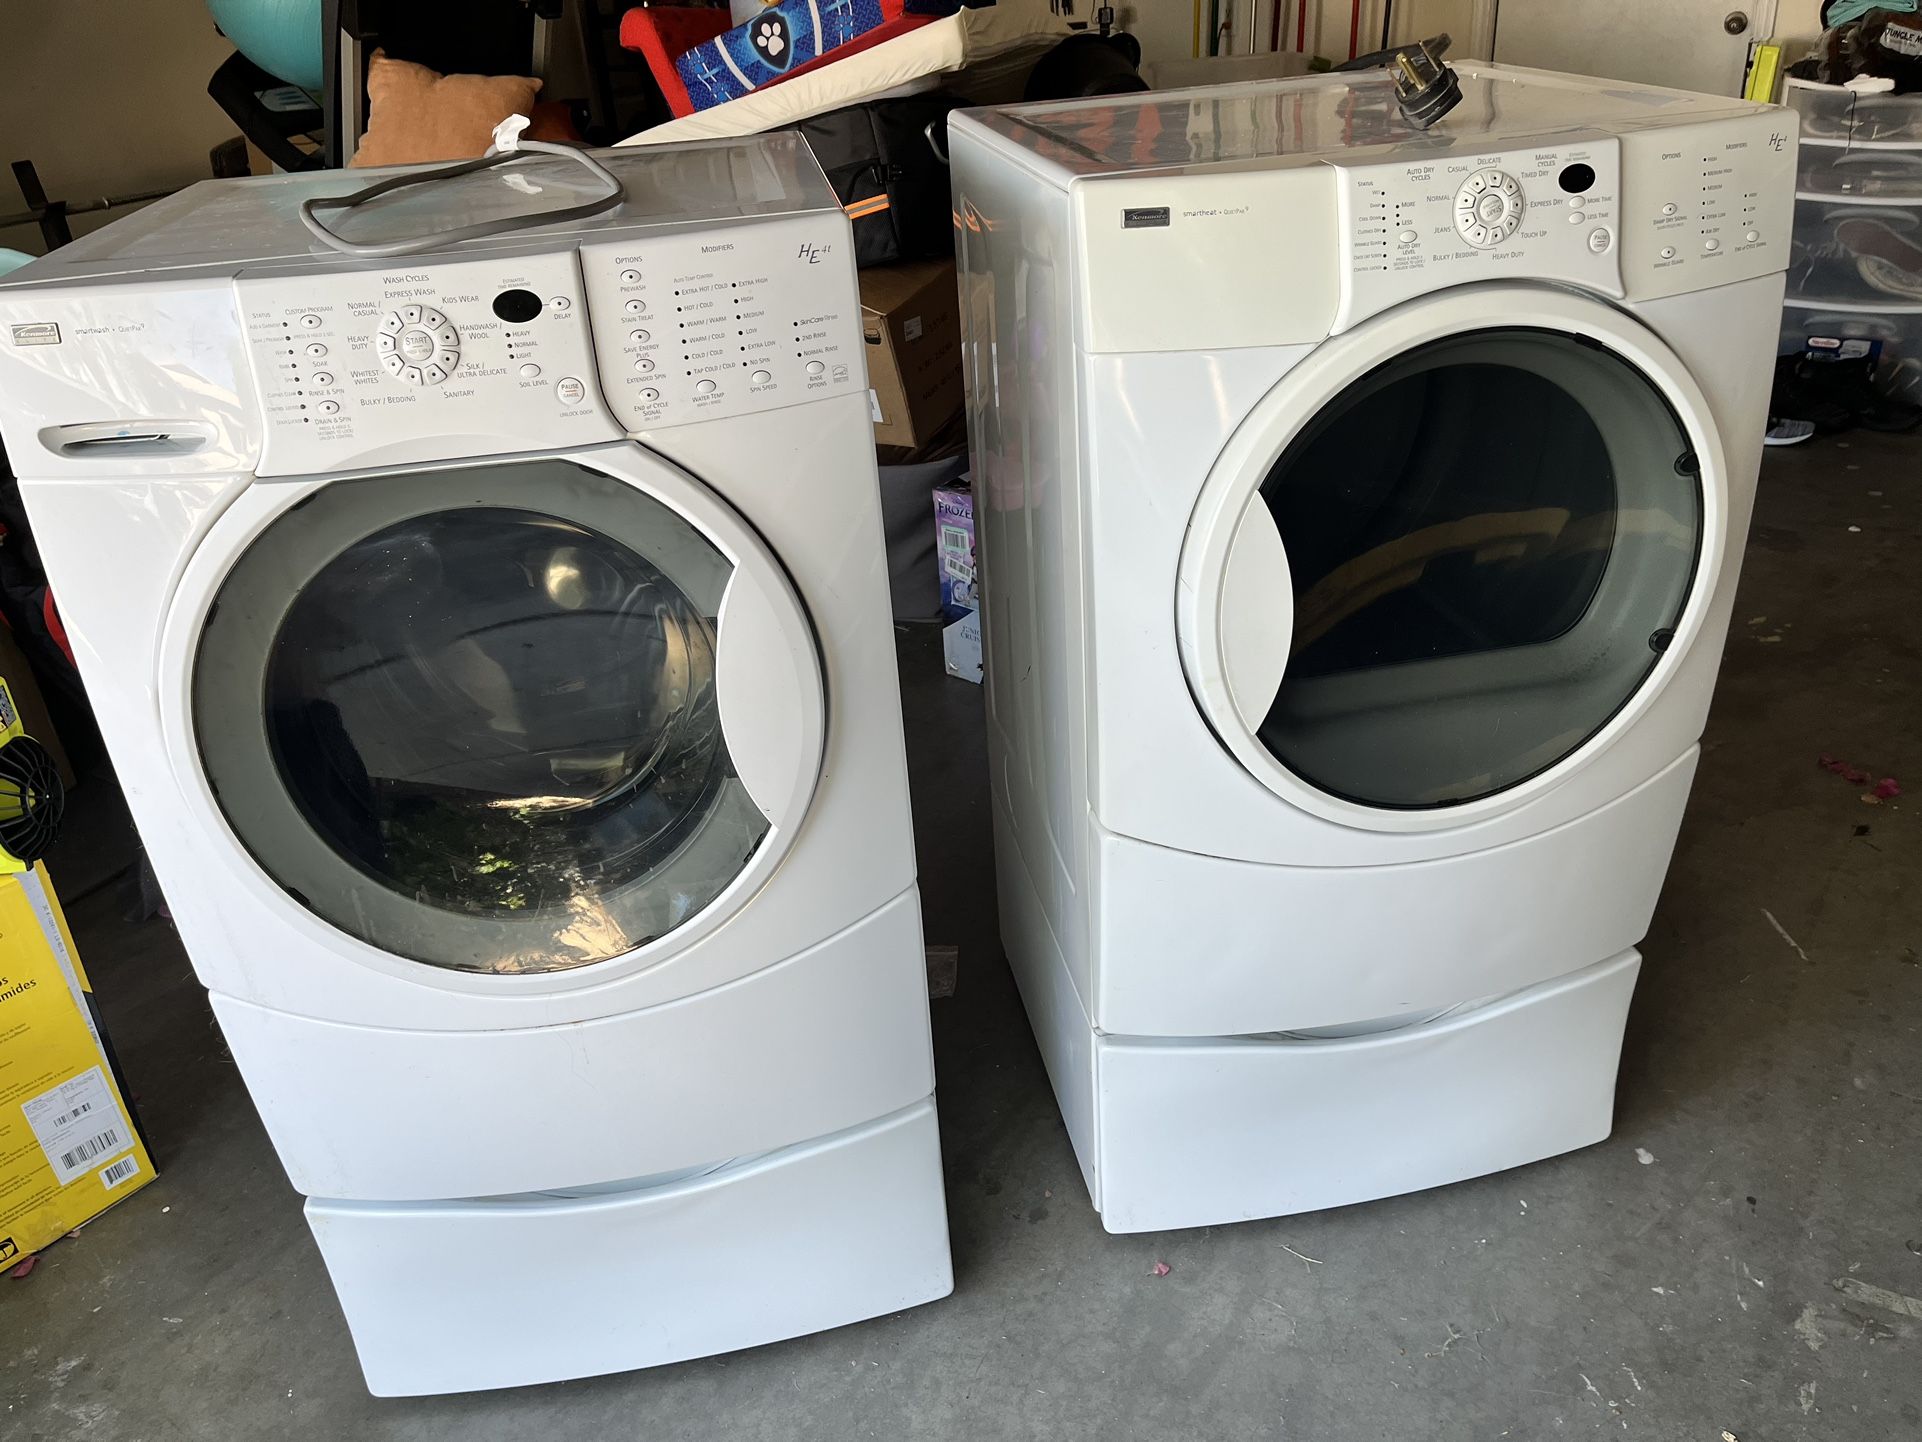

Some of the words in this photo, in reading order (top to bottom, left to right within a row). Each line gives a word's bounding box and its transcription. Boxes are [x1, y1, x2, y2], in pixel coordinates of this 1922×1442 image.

[1662, 152, 1681, 160] OPTIONS
[1477, 157, 1501, 165] DELICATE
[1530, 200, 1552, 208] EXPRESS
[1183, 209, 1217, 217] smartheat
[701, 244, 734, 253] MODIFIERS
[615, 256, 643, 264] OPTIONS
[1433, 254, 1450, 262] BULKY
[1455, 251, 1479, 259] BEDDING
[383, 276, 404, 284] WASH
[405, 275, 430, 283] CYCLES
[385, 290, 412, 299] EXPRESS
[414, 288, 436, 296] WASH
[681, 287, 698, 295] EXTRA
[442, 296, 457, 304] KIDS
[307, 306, 333, 314] PROGRAM
[347, 302, 376, 310] NORMAL
[353, 309, 378, 317] CASUAL
[743, 311, 765, 319] MEDIUM
[74, 326, 110, 335] smartwash
[459, 322, 497, 331] HANDWASH
[347, 335, 369, 343] HEAVY
[469, 332, 489, 340] WOOL
[406, 336, 427, 345] START
[638, 344, 659, 352] ENERGY
[466, 362, 480, 370] SILK
[704, 365, 718, 373] COLD
[722, 362, 736, 370] COLD
[351, 370, 379, 378] WHITEST
[479, 368, 507, 376] DELICATE
[354, 377, 379, 385] WHITES
[532, 379, 549, 387] LEVEL
[626, 375, 653, 384] EXTENDED
[807, 381, 828, 389] OPTIONS
[443, 390, 475, 399] SANITARY
[360, 398, 381, 406] BULKY
[387, 395, 416, 404] BEDDING
[692, 395, 710, 403] WATER
[634, 404, 645, 412] END
[643, 409, 662, 417] SIGNAL
[0, 979, 37, 1003] mides
